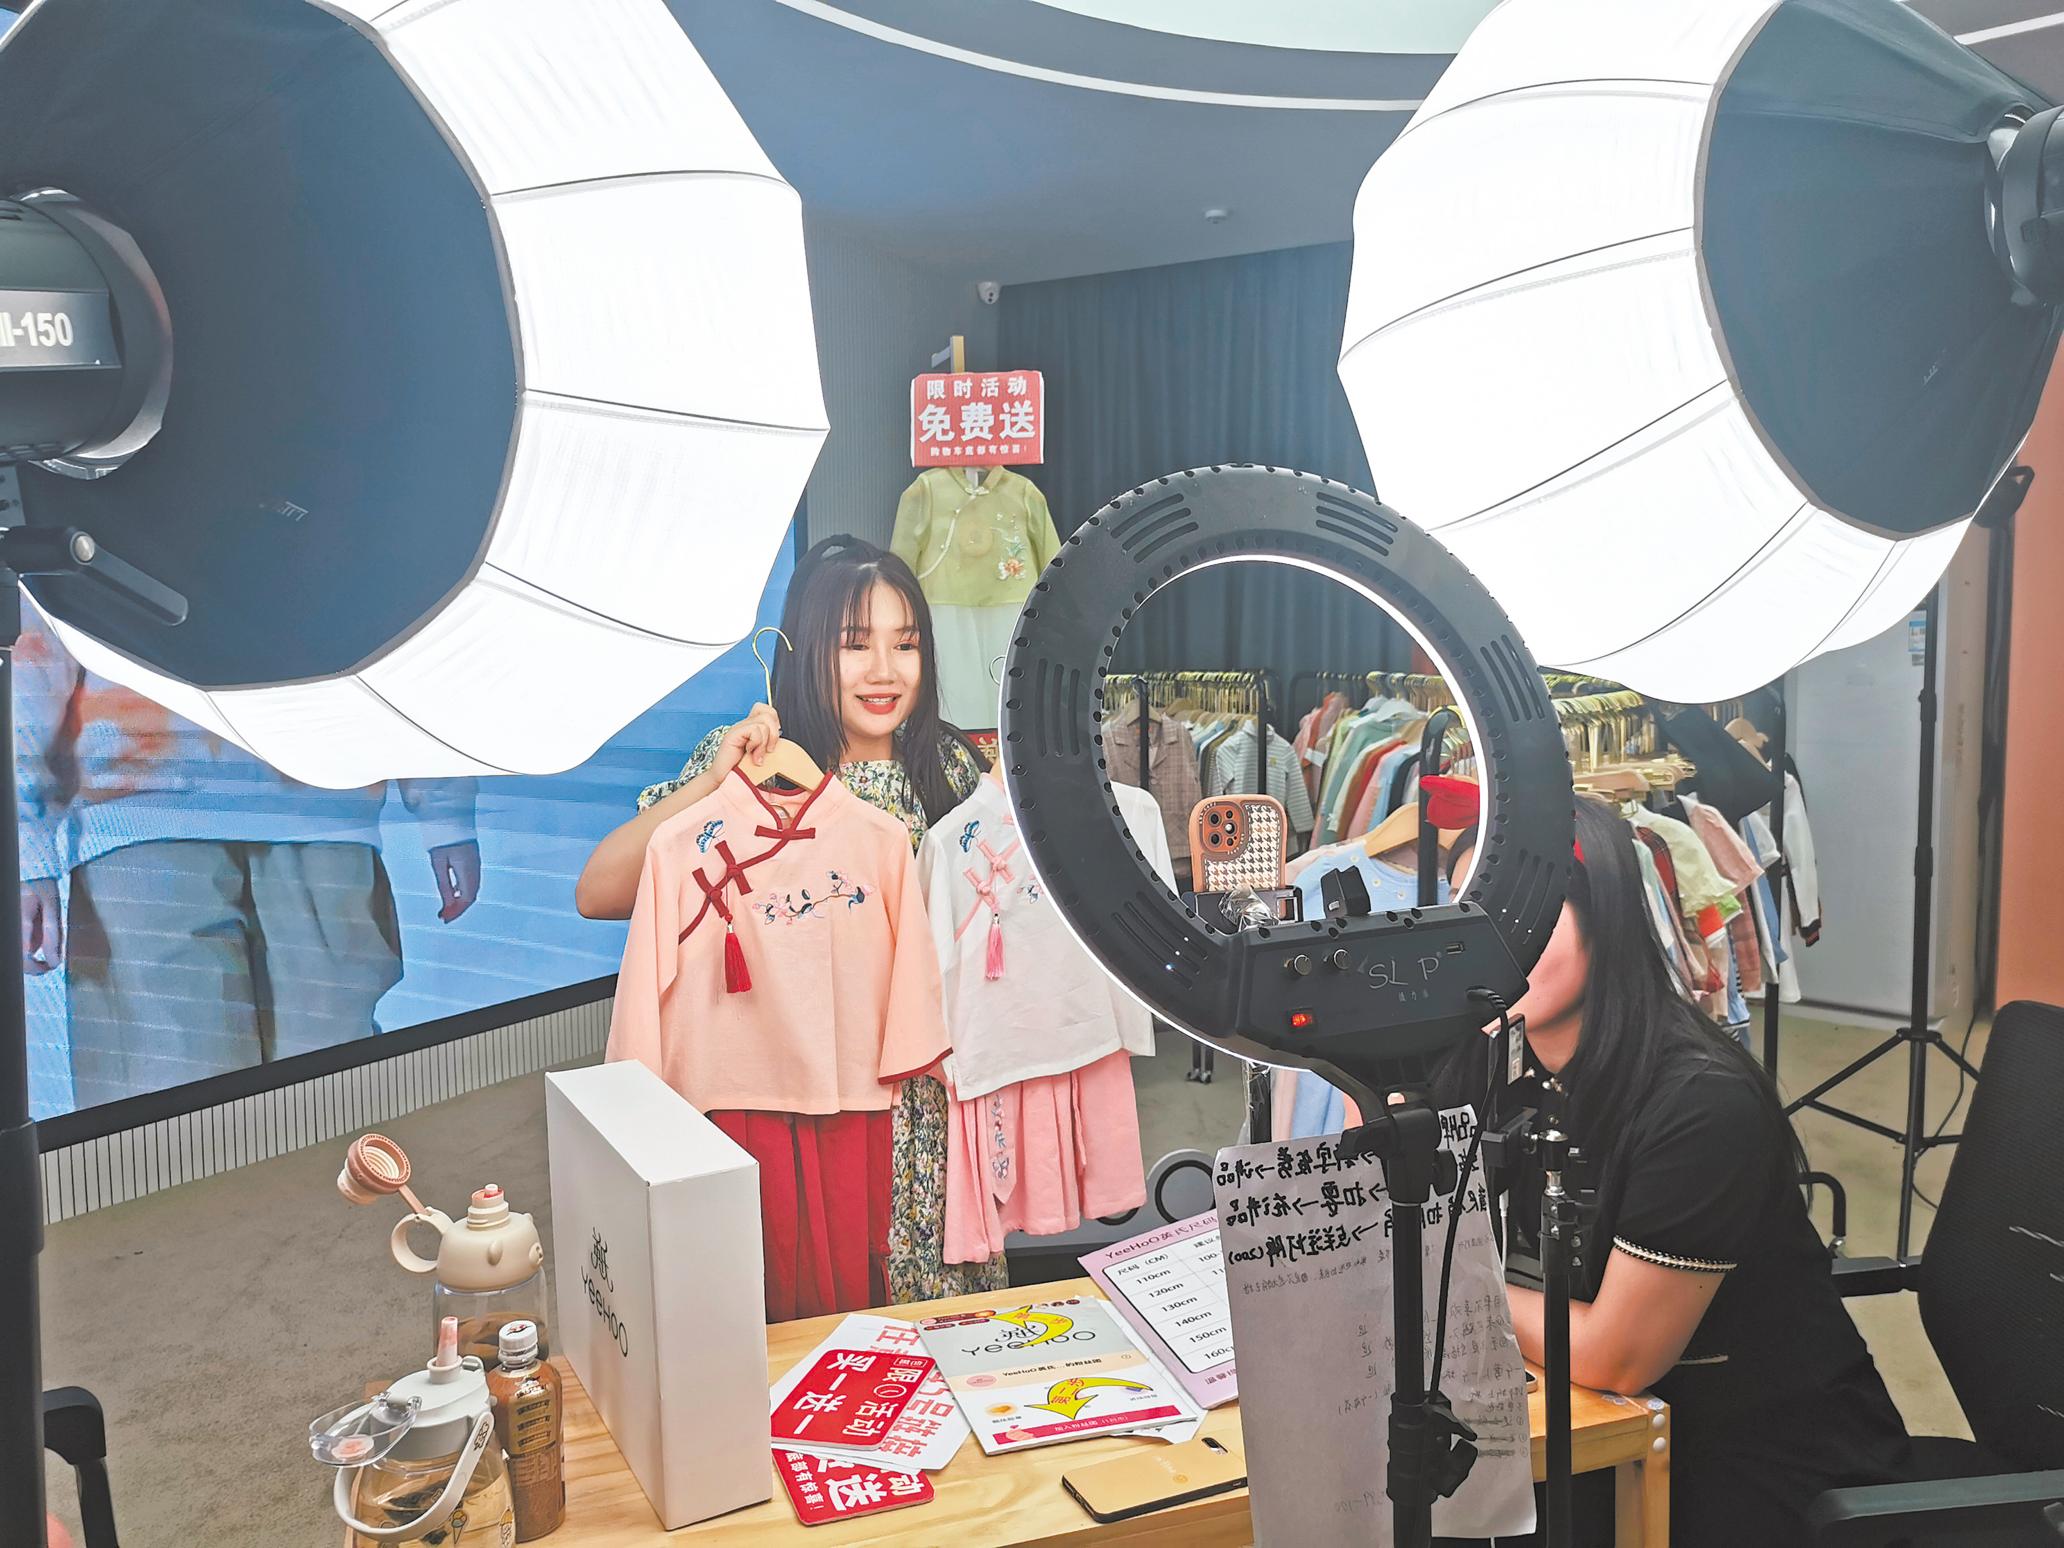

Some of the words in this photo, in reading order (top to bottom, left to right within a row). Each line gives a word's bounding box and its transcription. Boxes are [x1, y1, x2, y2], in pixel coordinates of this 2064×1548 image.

[927, 376, 1027, 400] 限时活动
[918, 400, 1036, 443] 免费送
[1136, 1269, 1171, 1284] 110cm
[1147, 1282, 1184, 1298] 120cm
[1161, 1296, 1198, 1312] 130cm
[1174, 1311, 1212, 1327] 140cm
[1188, 1326, 1227, 1344] 150cm
[793, 1353, 877, 1435] 买一送一
